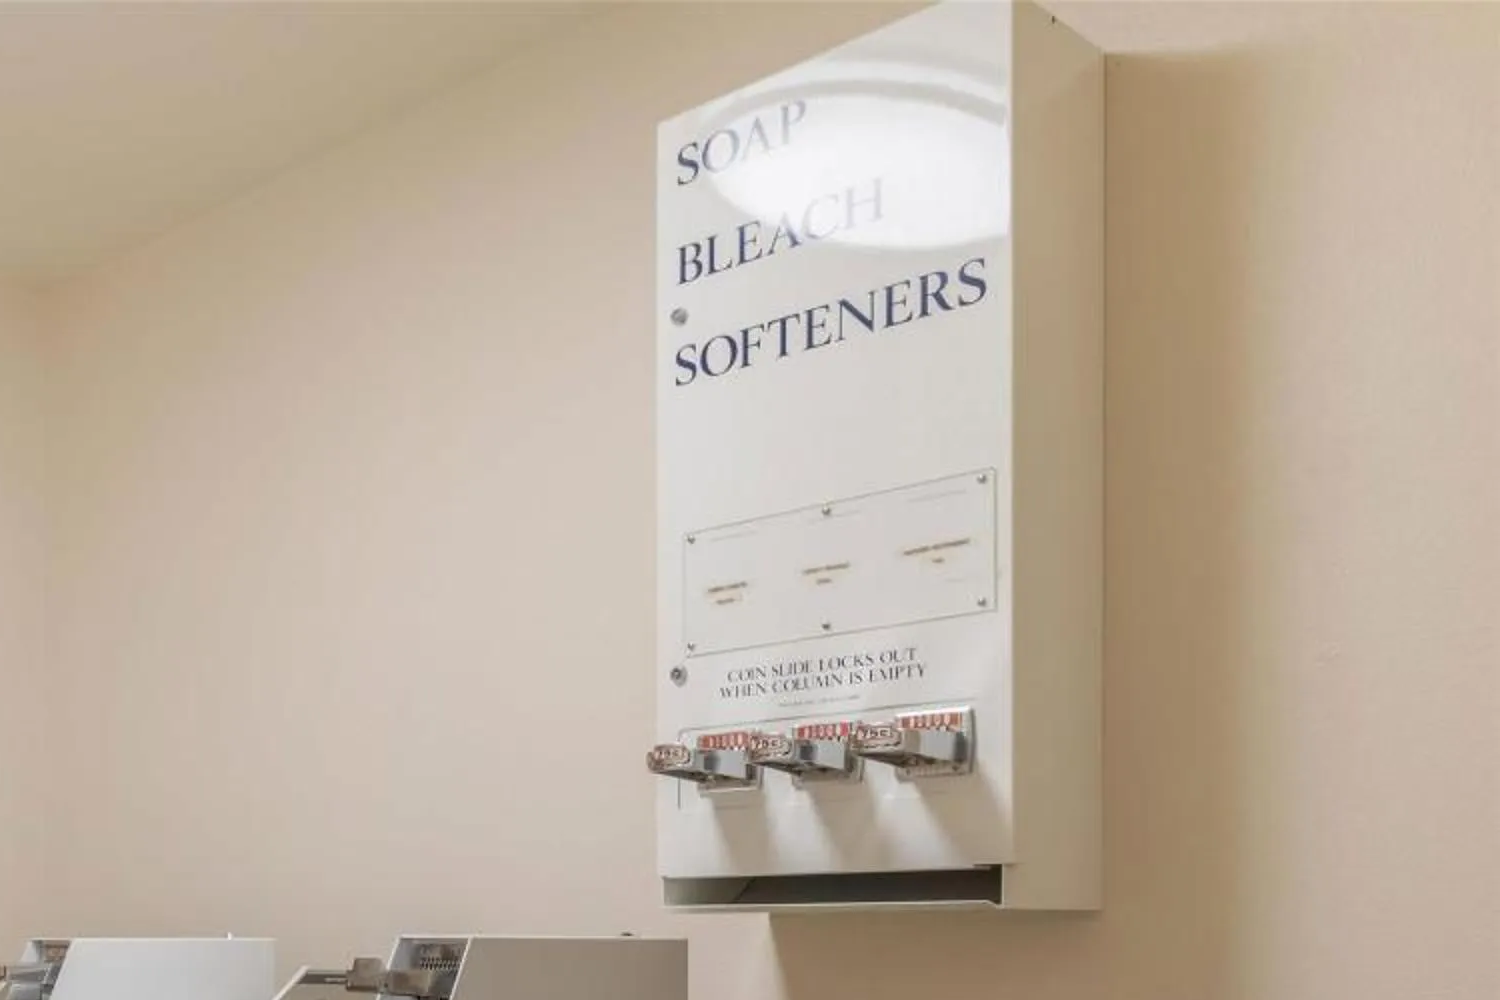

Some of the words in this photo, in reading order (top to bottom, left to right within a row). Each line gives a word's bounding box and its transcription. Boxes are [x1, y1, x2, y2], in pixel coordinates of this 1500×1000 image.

[676, 99, 807, 187] SOAP
[676, 175, 885, 286] BLEACH
[674, 256, 988, 387] SOFTENERS
[718, 682, 767, 699] WHEN
[771, 671, 843, 693] COLUMN
[847, 669, 863, 685] IS
[868, 662, 928, 683] EMPTY
[727, 665, 767, 682] COIN
[771, 657, 814, 677] SLIDE
[818, 653, 874, 672] LOCKS
[879, 647, 917, 663] OUT
